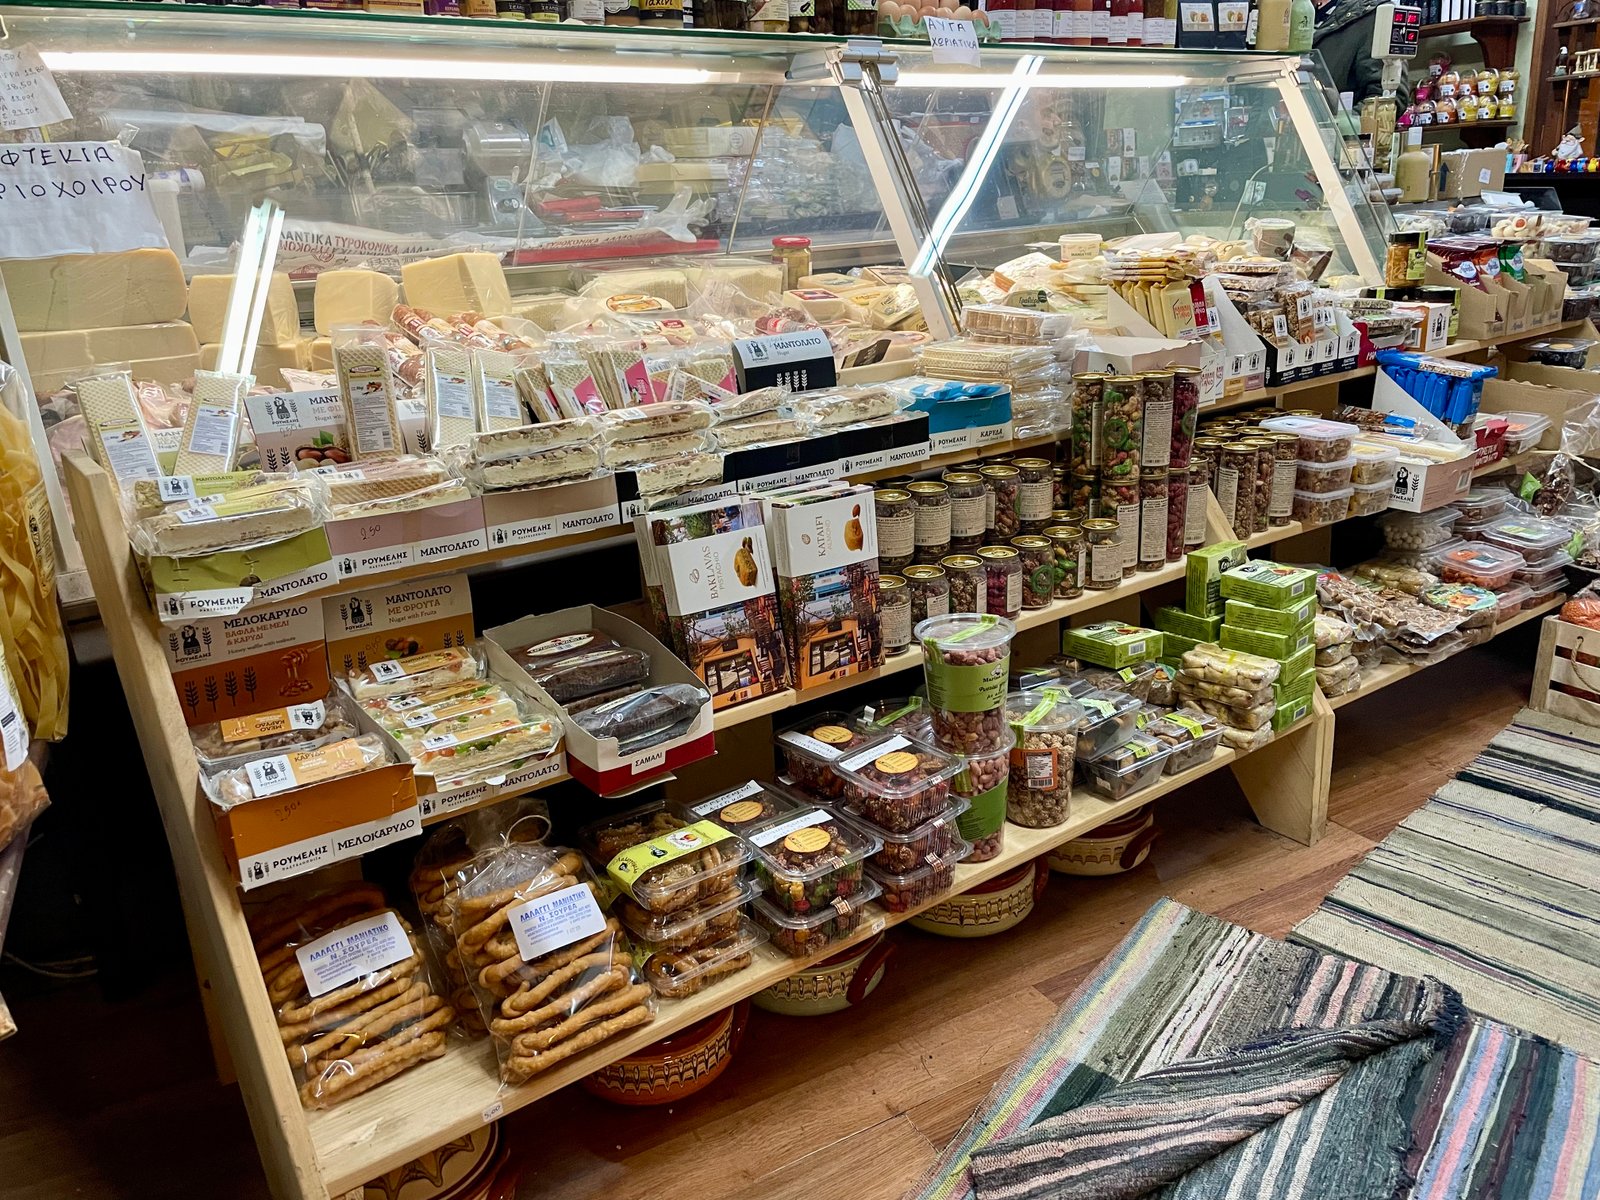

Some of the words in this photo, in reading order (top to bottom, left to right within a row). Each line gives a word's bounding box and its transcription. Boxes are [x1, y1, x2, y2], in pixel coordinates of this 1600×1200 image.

[928, 18, 966, 32] ΑΥΓΑ
[931, 37, 978, 50] ΧΩΡΙΑΤΙΚΑ
[773, 337, 822, 350] ΜΑΝΤΟΛΑΤΟ
[938, 434, 967, 446] ΡΟΥΜΕΛΗΣ
[854, 456, 883, 467] ΡΟΥΜΕΛΗΣ
[889, 448, 927, 463] ΜΑΝΤΟΛΑΤΟ
[756, 476, 788, 489] ΡΟΥΜΕΛΗΣ
[794, 468, 835, 483] ΜΑΝΤΟΛΑΤΟ
[512, 523, 552, 537] ΡΟΥΜΕΛΗΣ
[561, 513, 615, 530] ΜΑΝΤΟΛΑΤΟ
[817, 515, 828, 558] KATAIFI
[361, 550, 408, 567] ΡΟΥΜΕΛΗΣ
[419, 538, 480, 558] ΜΑΝΤΟΛΑΤΟ
[701, 544, 719, 600] BAKLAVAS
[190, 595, 246, 610] ΡΟΥΜΕΛΗΣ
[260, 571, 329, 600] ΜΑΝΤΟΛΑΤΟ
[385, 585, 452, 606] ΜΑΝΤΟΛΑΤΟ
[223, 605, 309, 630] ΜΕΛΟΚΑΡΥΔΟ
[387, 606, 402, 616] ΜΕ
[402, 599, 441, 613] ΦΡΟΥΤΑ
[407, 612, 421, 620] with
[224, 627, 256, 639] ΒΑΦΛΑ
[256, 624, 270, 633] ΜΕ
[271, 620, 290, 630] ΜΕΛΙ
[233, 633, 264, 645] ΚΑΡΥΔΙ
[633, 751, 664, 769] ΣΑΜΑΛΙ
[440, 784, 489, 807] ΡΟΥΜΕΛΗΣ
[499, 762, 561, 790] ΜΑΝΤΟΛΑΤΟ
[272, 844, 329, 870] ΡΟΥΜΕΛΗΣ
[337, 818, 416, 852] ΜΕΛΟΚΑΡΥΔΟ
[519, 904, 552, 923] ΛΑΛΑΓΓΙ
[551, 890, 586, 909] ΜΑΝΙΑΤΙΚΟ
[309, 941, 345, 962] ΛΑΛΑΓΓΙ
[346, 923, 390, 944] ΜΑΝΙΑΤΙΚΟ
[341, 936, 379, 955] ΣΟΥΡΕΑ
